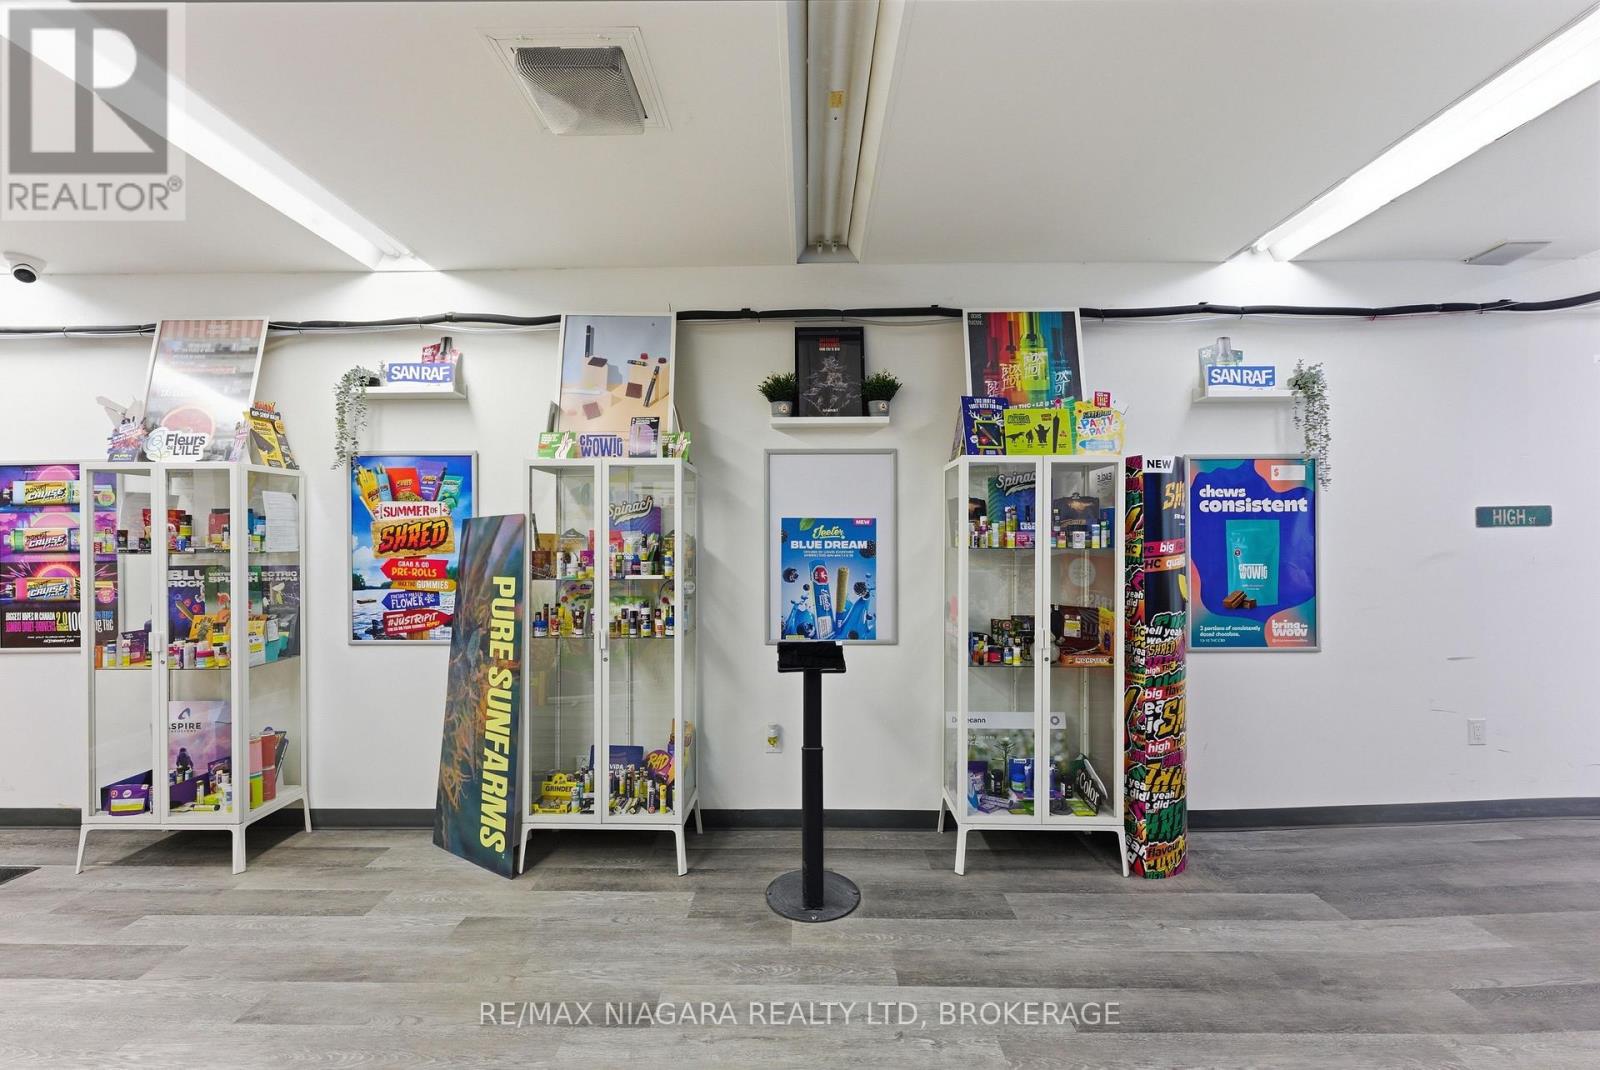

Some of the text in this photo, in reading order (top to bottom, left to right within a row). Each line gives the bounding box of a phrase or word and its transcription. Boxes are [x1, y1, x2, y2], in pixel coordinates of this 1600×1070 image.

[391, 365, 420, 380] SAN
[1211, 368, 1240, 384] SAN
[1080, 414, 1114, 430] PARTY
[165, 434, 206, 446] Fleurs
[1146, 460, 1172, 468] NEW
[996, 471, 1036, 491] Spinac
[28, 488, 65, 500] CRUISE
[1199, 484, 1246, 498] chews
[384, 506, 430, 518] SUMMER
[608, 495, 654, 520] Spinach
[1199, 498, 1308, 512] consistent
[1492, 509, 1526, 525] HIGH
[378, 520, 448, 554] SHRED
[812, 525, 846, 539] Jeeter
[29, 536, 65, 549] CRUISE
[790, 540, 868, 550] BLUE DREAM
[1160, 542, 1174, 553] big
[392, 568, 437, 577] PRE-ROLLS
[30, 584, 67, 598] CRUISE
[416, 580, 448, 590] GUMMIES
[391, 597, 424, 609] FLOWER
[1148, 641, 1176, 657] SHRED
[1146, 689, 1164, 700] big
[480, 576, 516, 853] PURE SUNFARMS
[1148, 740, 1170, 754] high
[1079, 772, 1100, 806] Color
[1153, 801, 1170, 810] did
